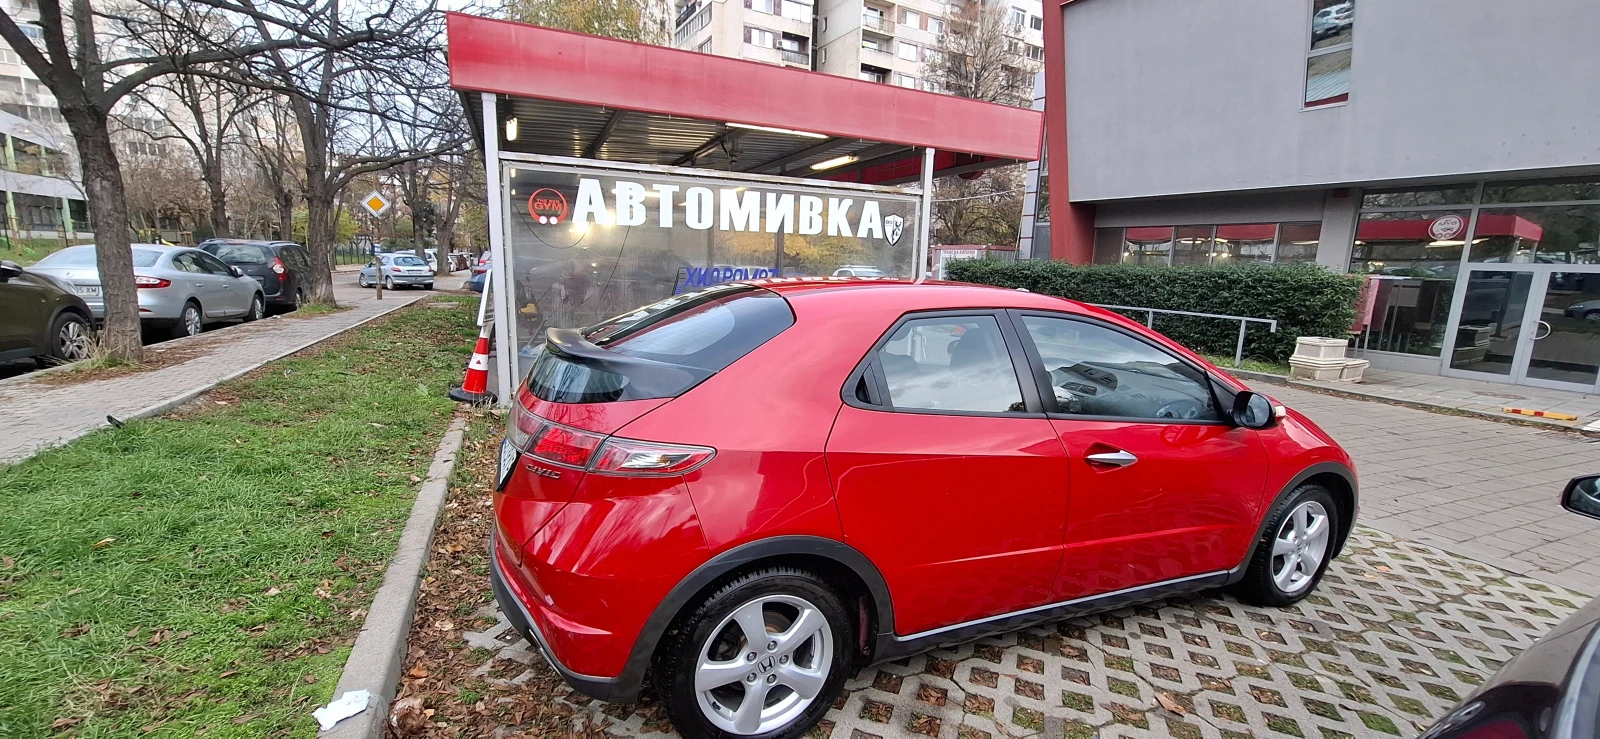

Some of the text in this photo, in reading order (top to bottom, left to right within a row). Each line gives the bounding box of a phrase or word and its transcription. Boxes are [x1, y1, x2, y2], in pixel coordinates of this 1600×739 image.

[534, 202, 562, 211] GYM
[571, 178, 883, 239] АВТОМИВКА
[526, 463, 562, 479] CIVIC
